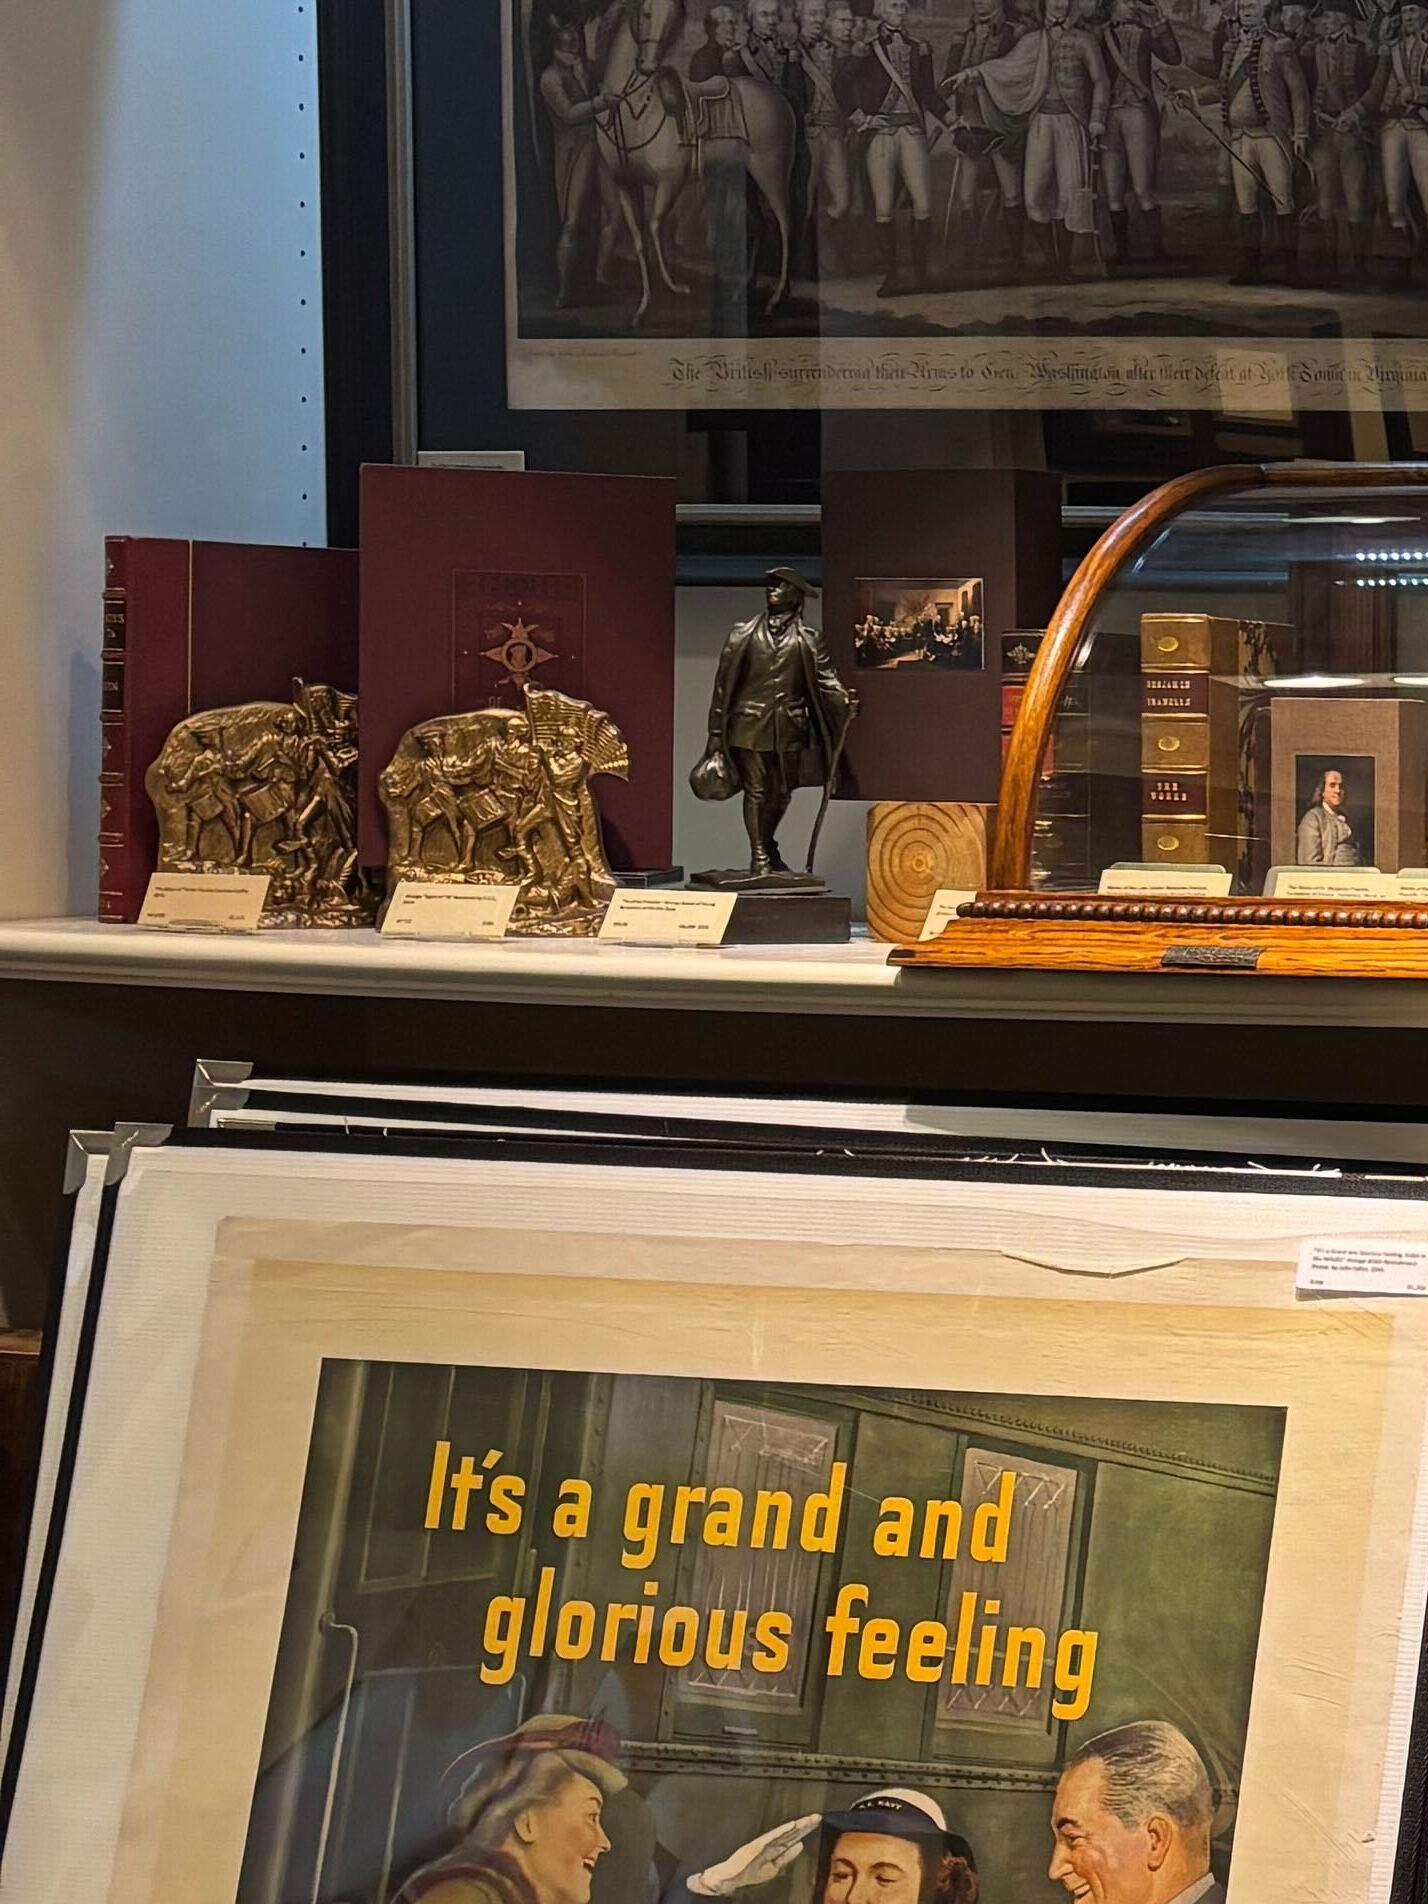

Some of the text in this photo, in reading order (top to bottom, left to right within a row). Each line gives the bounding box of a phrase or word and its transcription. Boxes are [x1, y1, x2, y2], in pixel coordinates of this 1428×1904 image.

[422, 1440, 1017, 1571] It's a grand and
[479, 1566, 1099, 1722] glorious feeling
